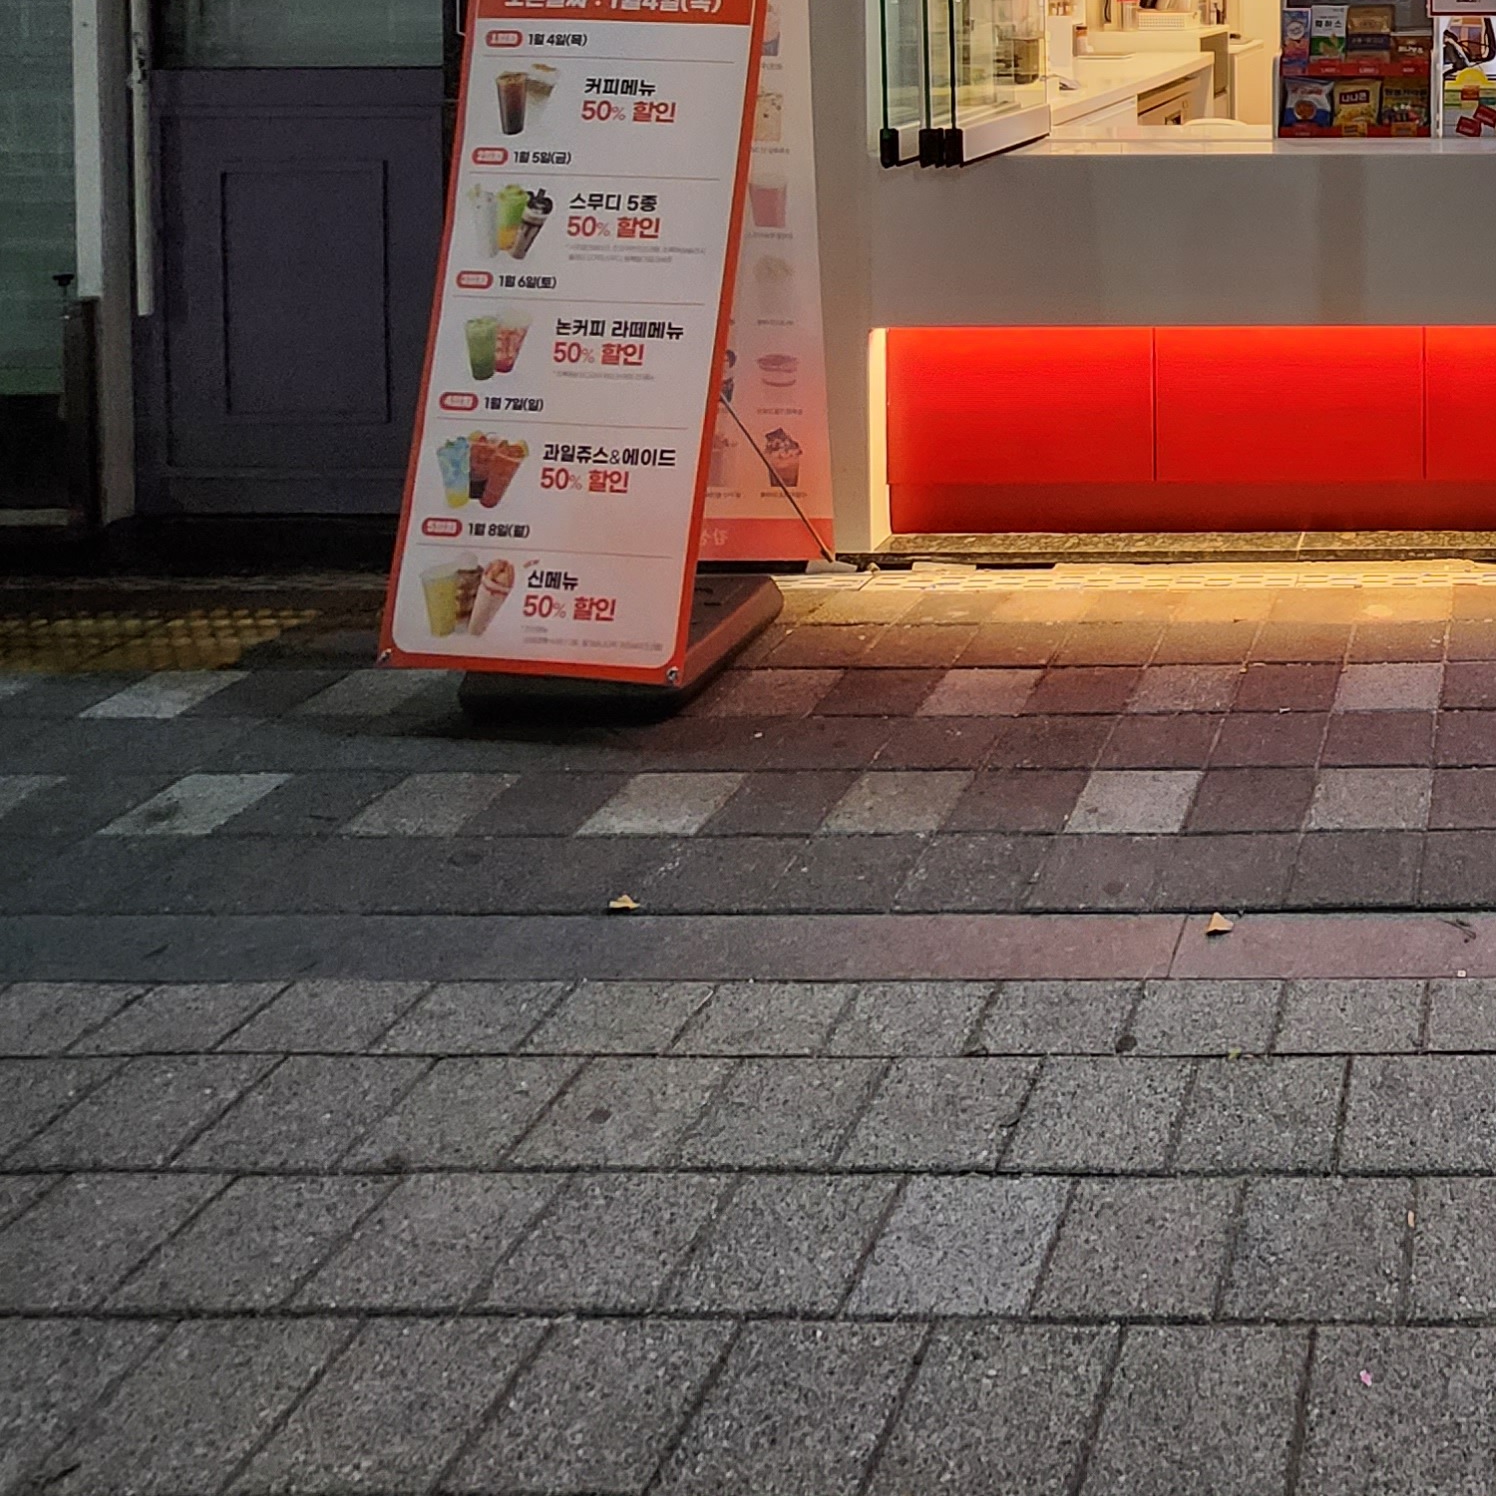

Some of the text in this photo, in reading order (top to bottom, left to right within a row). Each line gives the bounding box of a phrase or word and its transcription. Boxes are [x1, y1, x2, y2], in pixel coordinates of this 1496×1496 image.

[527, 33, 545, 46] 1월
[583, 77, 656, 97] 커피메뉴
[581, 100, 676, 123] 50% 할인
[569, 192, 658, 213] 스무디 5종
[567, 215, 660, 239] 50% 할인
[555, 317, 684, 341] 논커피 라떼메뉴
[553, 341, 645, 366] 50% 할인
[542, 443, 677, 467] 과일쥬스&에이드
[540, 467, 630, 494] 50% 할인
[527, 570, 579, 591] 신메뉴
[523, 594, 617, 622] 50% 할인
